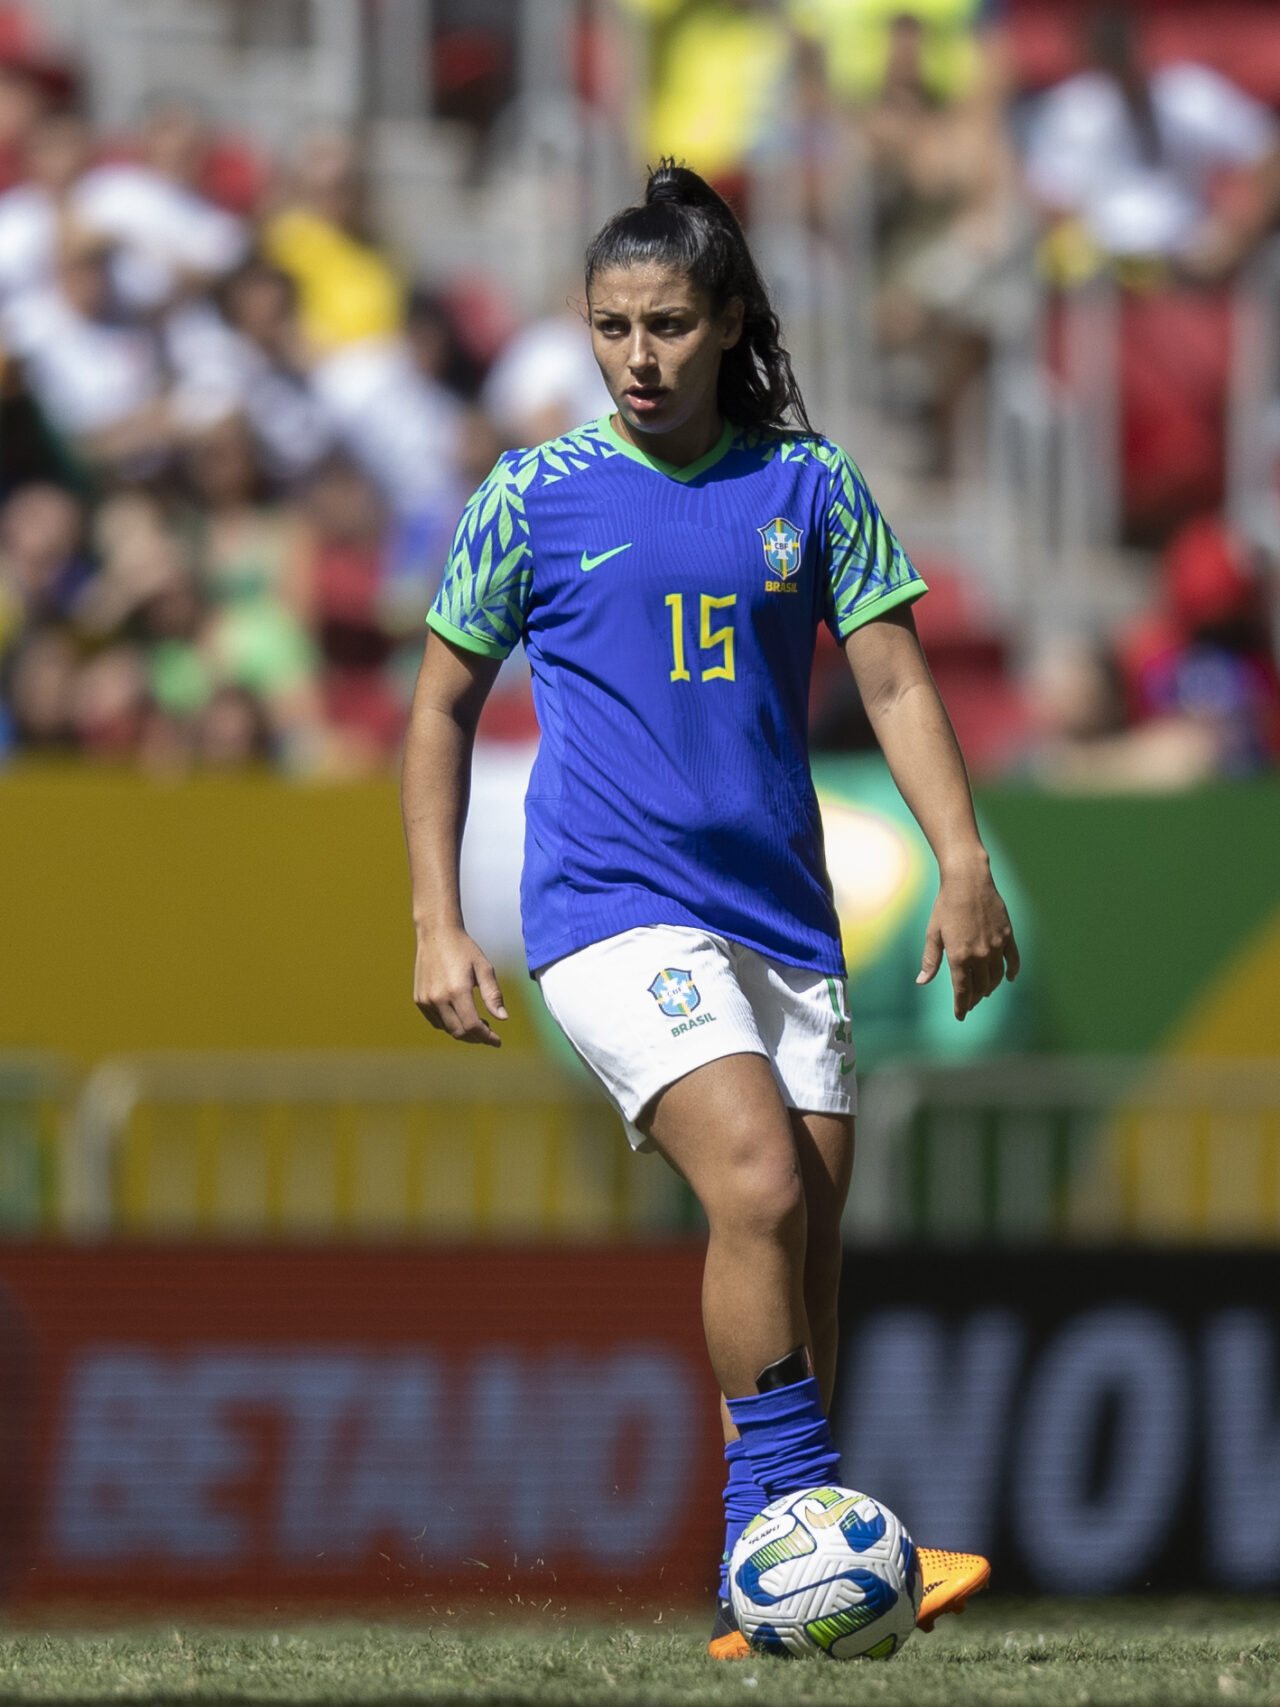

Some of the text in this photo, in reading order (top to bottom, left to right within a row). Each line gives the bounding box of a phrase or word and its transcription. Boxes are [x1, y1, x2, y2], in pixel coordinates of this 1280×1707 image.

[774, 542, 789, 550] CBF
[765, 581, 798, 593] BRASIL
[664, 593, 737, 682] 15
[671, 1012, 717, 1037] BRASIL
[50, 1342, 702, 1568] BETANO
